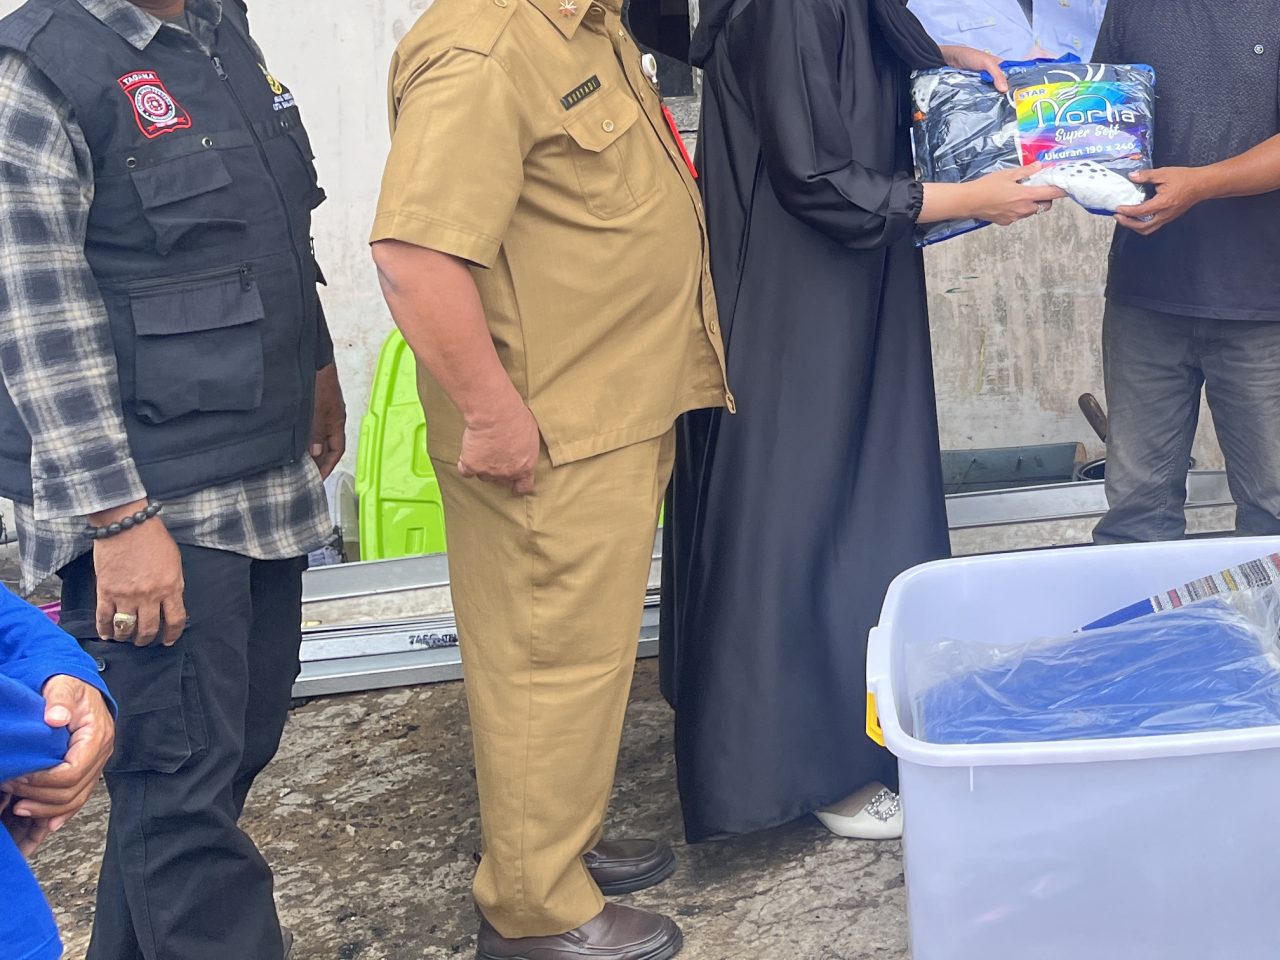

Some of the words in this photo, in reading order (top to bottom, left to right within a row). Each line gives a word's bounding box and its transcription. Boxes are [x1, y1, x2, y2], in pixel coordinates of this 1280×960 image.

[1019, 89, 1046, 100] STAR
[1055, 128, 1090, 144] Super
[1094, 123, 1121, 139] Soft
[1044, 147, 1083, 161] Ukuran
[1086, 144, 1103, 156] 190
[1115, 142, 1136, 153] 240
